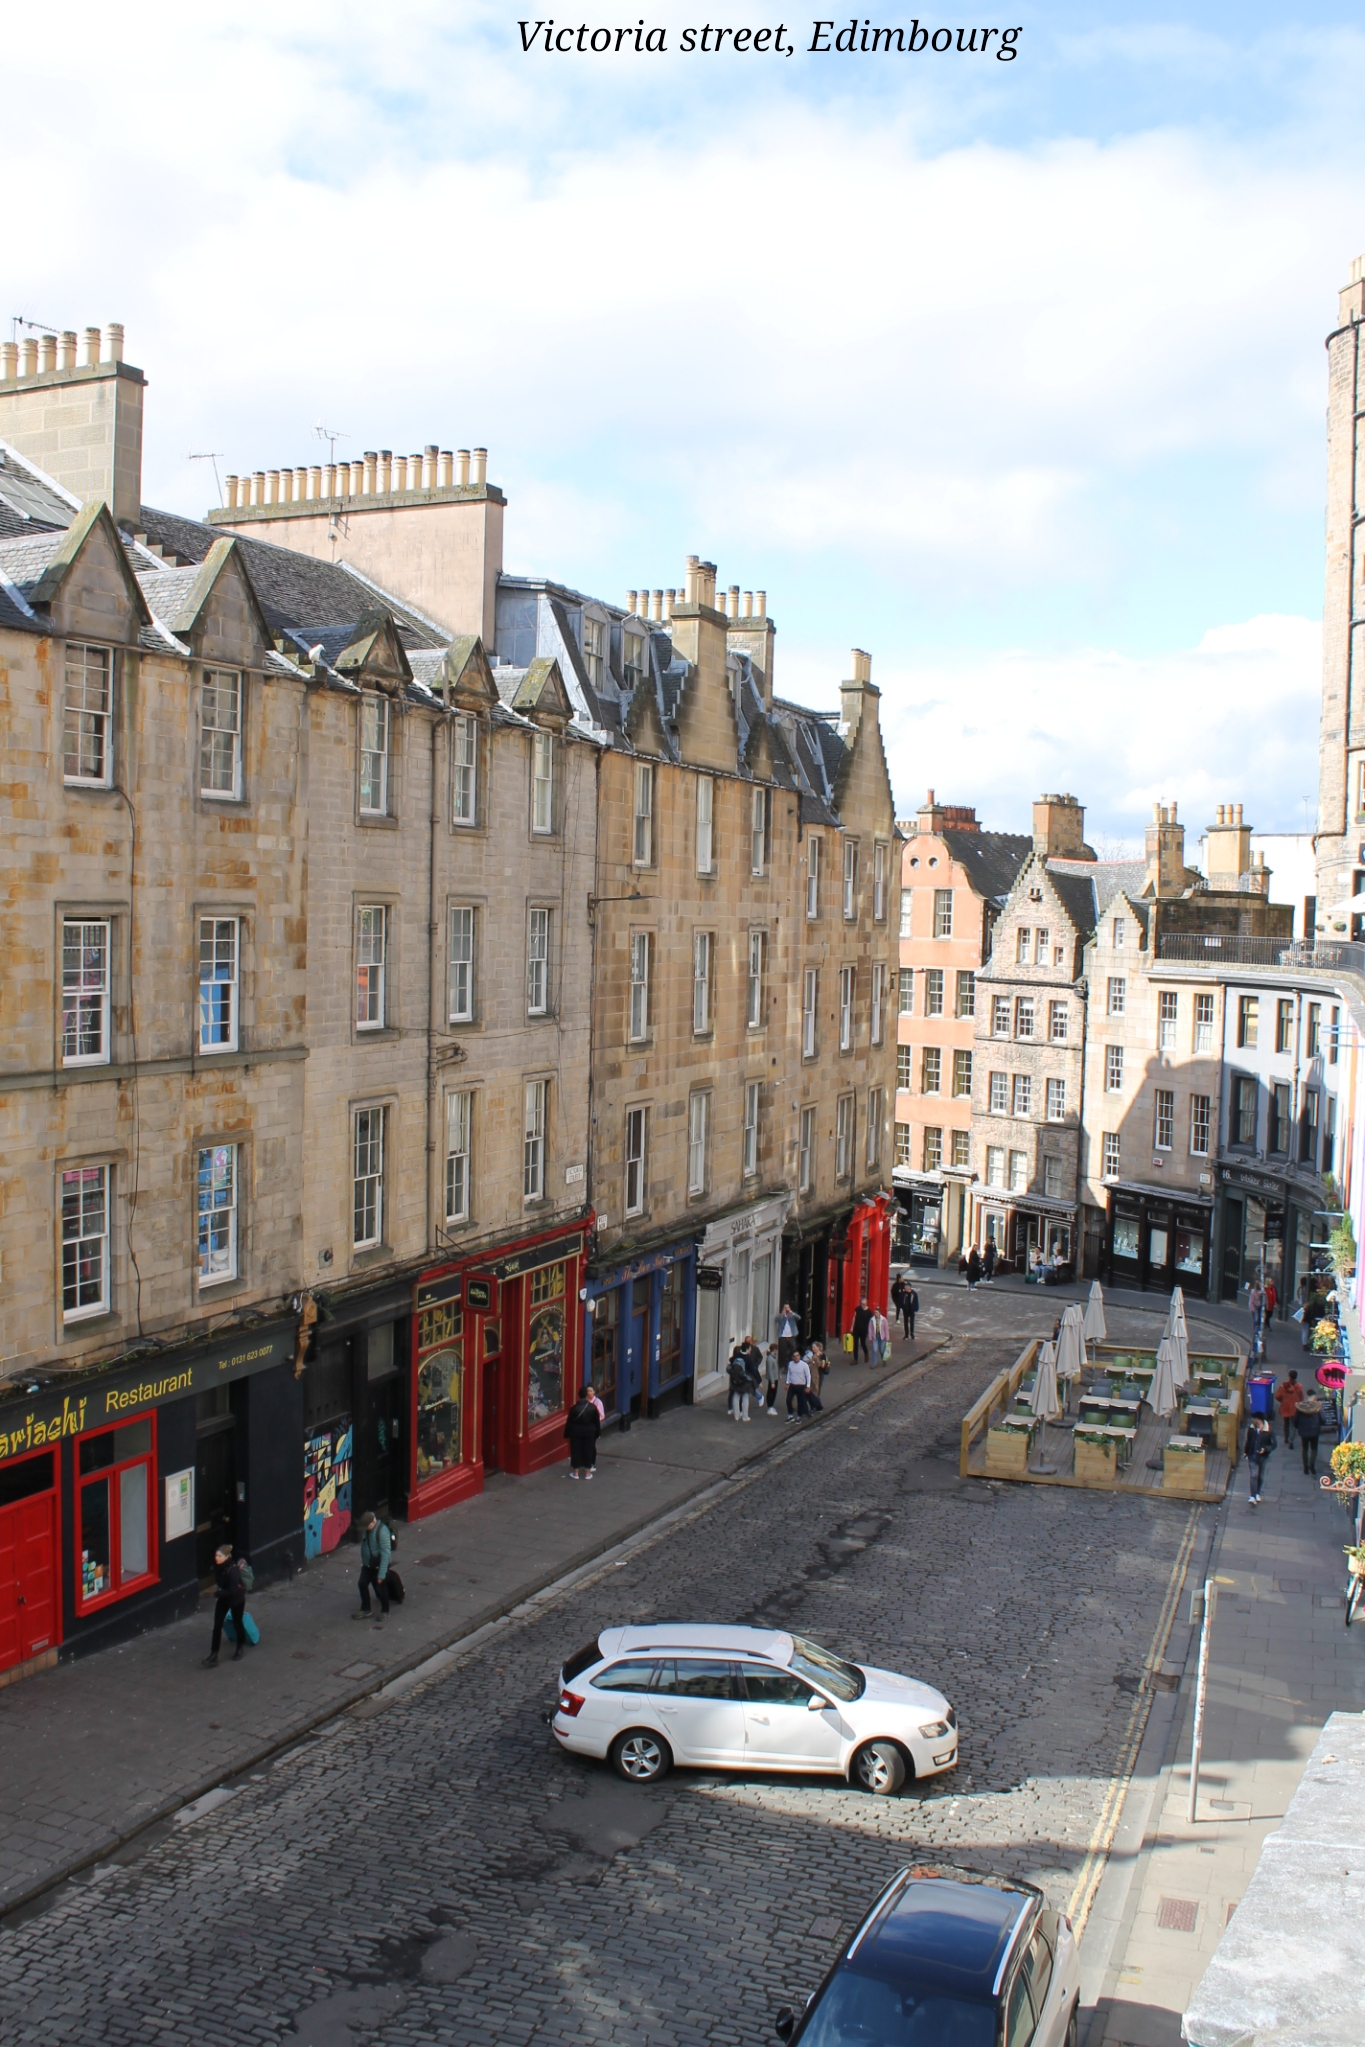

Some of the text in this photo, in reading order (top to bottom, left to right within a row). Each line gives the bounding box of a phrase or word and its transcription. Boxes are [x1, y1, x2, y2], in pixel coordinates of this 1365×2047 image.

[730, 1214, 755, 1235] SAHARA
[231, 1354, 245, 1366] 0131
[247, 1350, 258, 1361] 623
[259, 1344, 273, 1357] 0077
[106, 1368, 193, 1413] Restaurant
